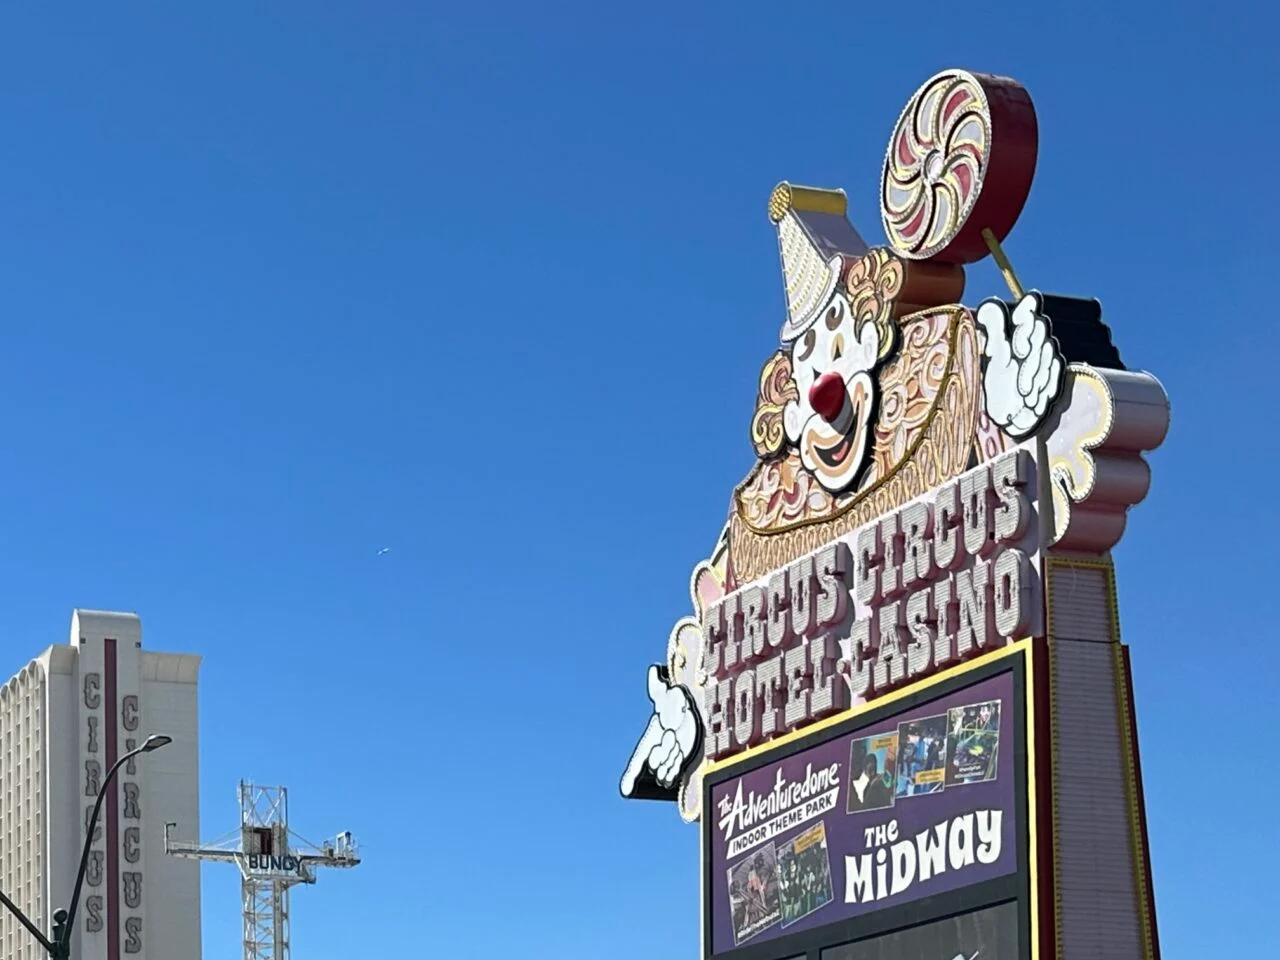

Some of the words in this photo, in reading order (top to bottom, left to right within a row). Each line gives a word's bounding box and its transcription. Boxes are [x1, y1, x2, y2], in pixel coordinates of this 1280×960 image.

[703, 633, 837, 759] HOTEL
[850, 548, 1025, 699] CASINO
[704, 541, 851, 673] CIRCUS
[856, 449, 1030, 606] CIRCUS
[83, 672, 104, 933] CIRCUS
[122, 695, 143, 954] CIRCUS
[248, 855, 304, 873] BUNGY
[719, 762, 840, 841] Adventuredome
[732, 825, 767, 854] INDOOR
[770, 809, 804, 835] THEME
[805, 793, 833, 817] PARK
